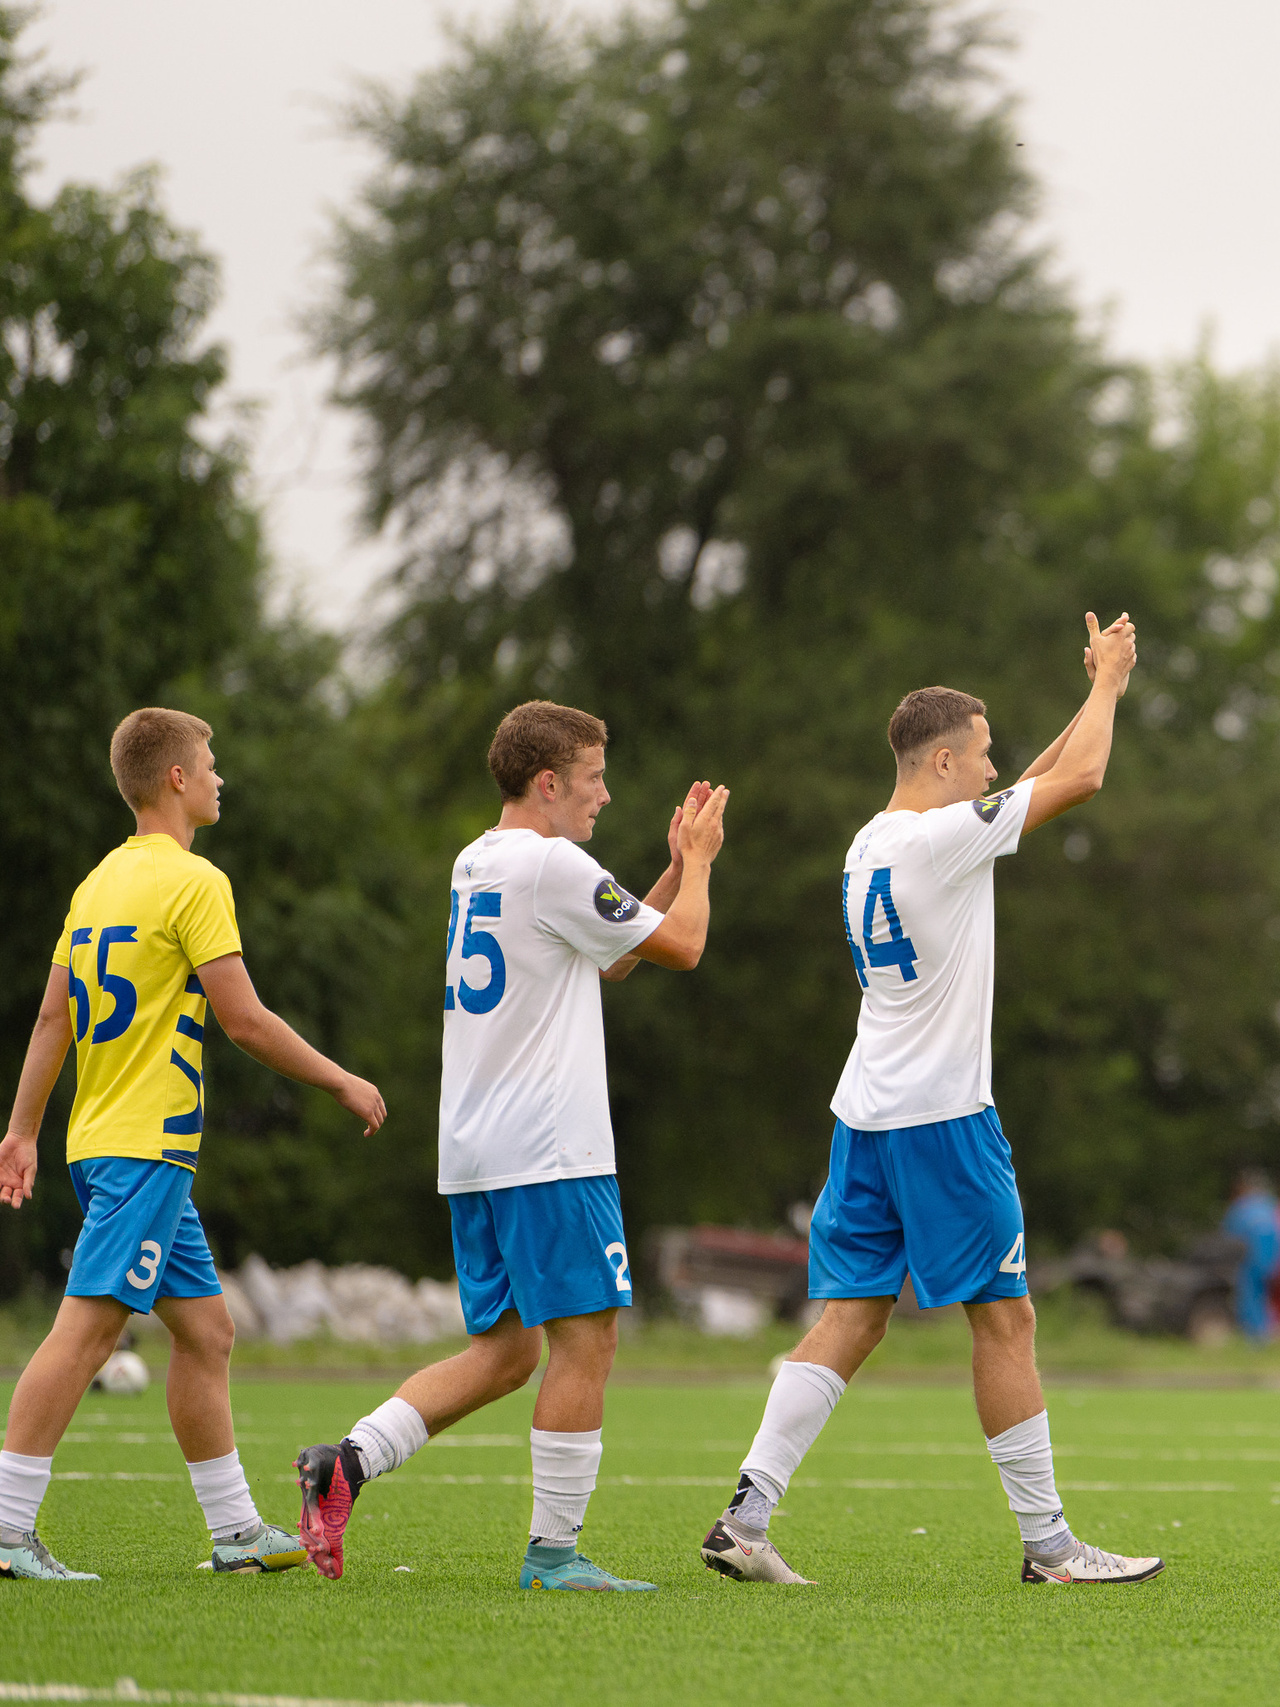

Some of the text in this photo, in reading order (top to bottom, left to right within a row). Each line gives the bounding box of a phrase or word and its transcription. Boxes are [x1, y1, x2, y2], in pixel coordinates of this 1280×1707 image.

[68, 925, 139, 1045] 55
[126, 1240, 162, 1290] 3
[604, 1241, 632, 1292] 2
[998, 1232, 1026, 1280] 4
